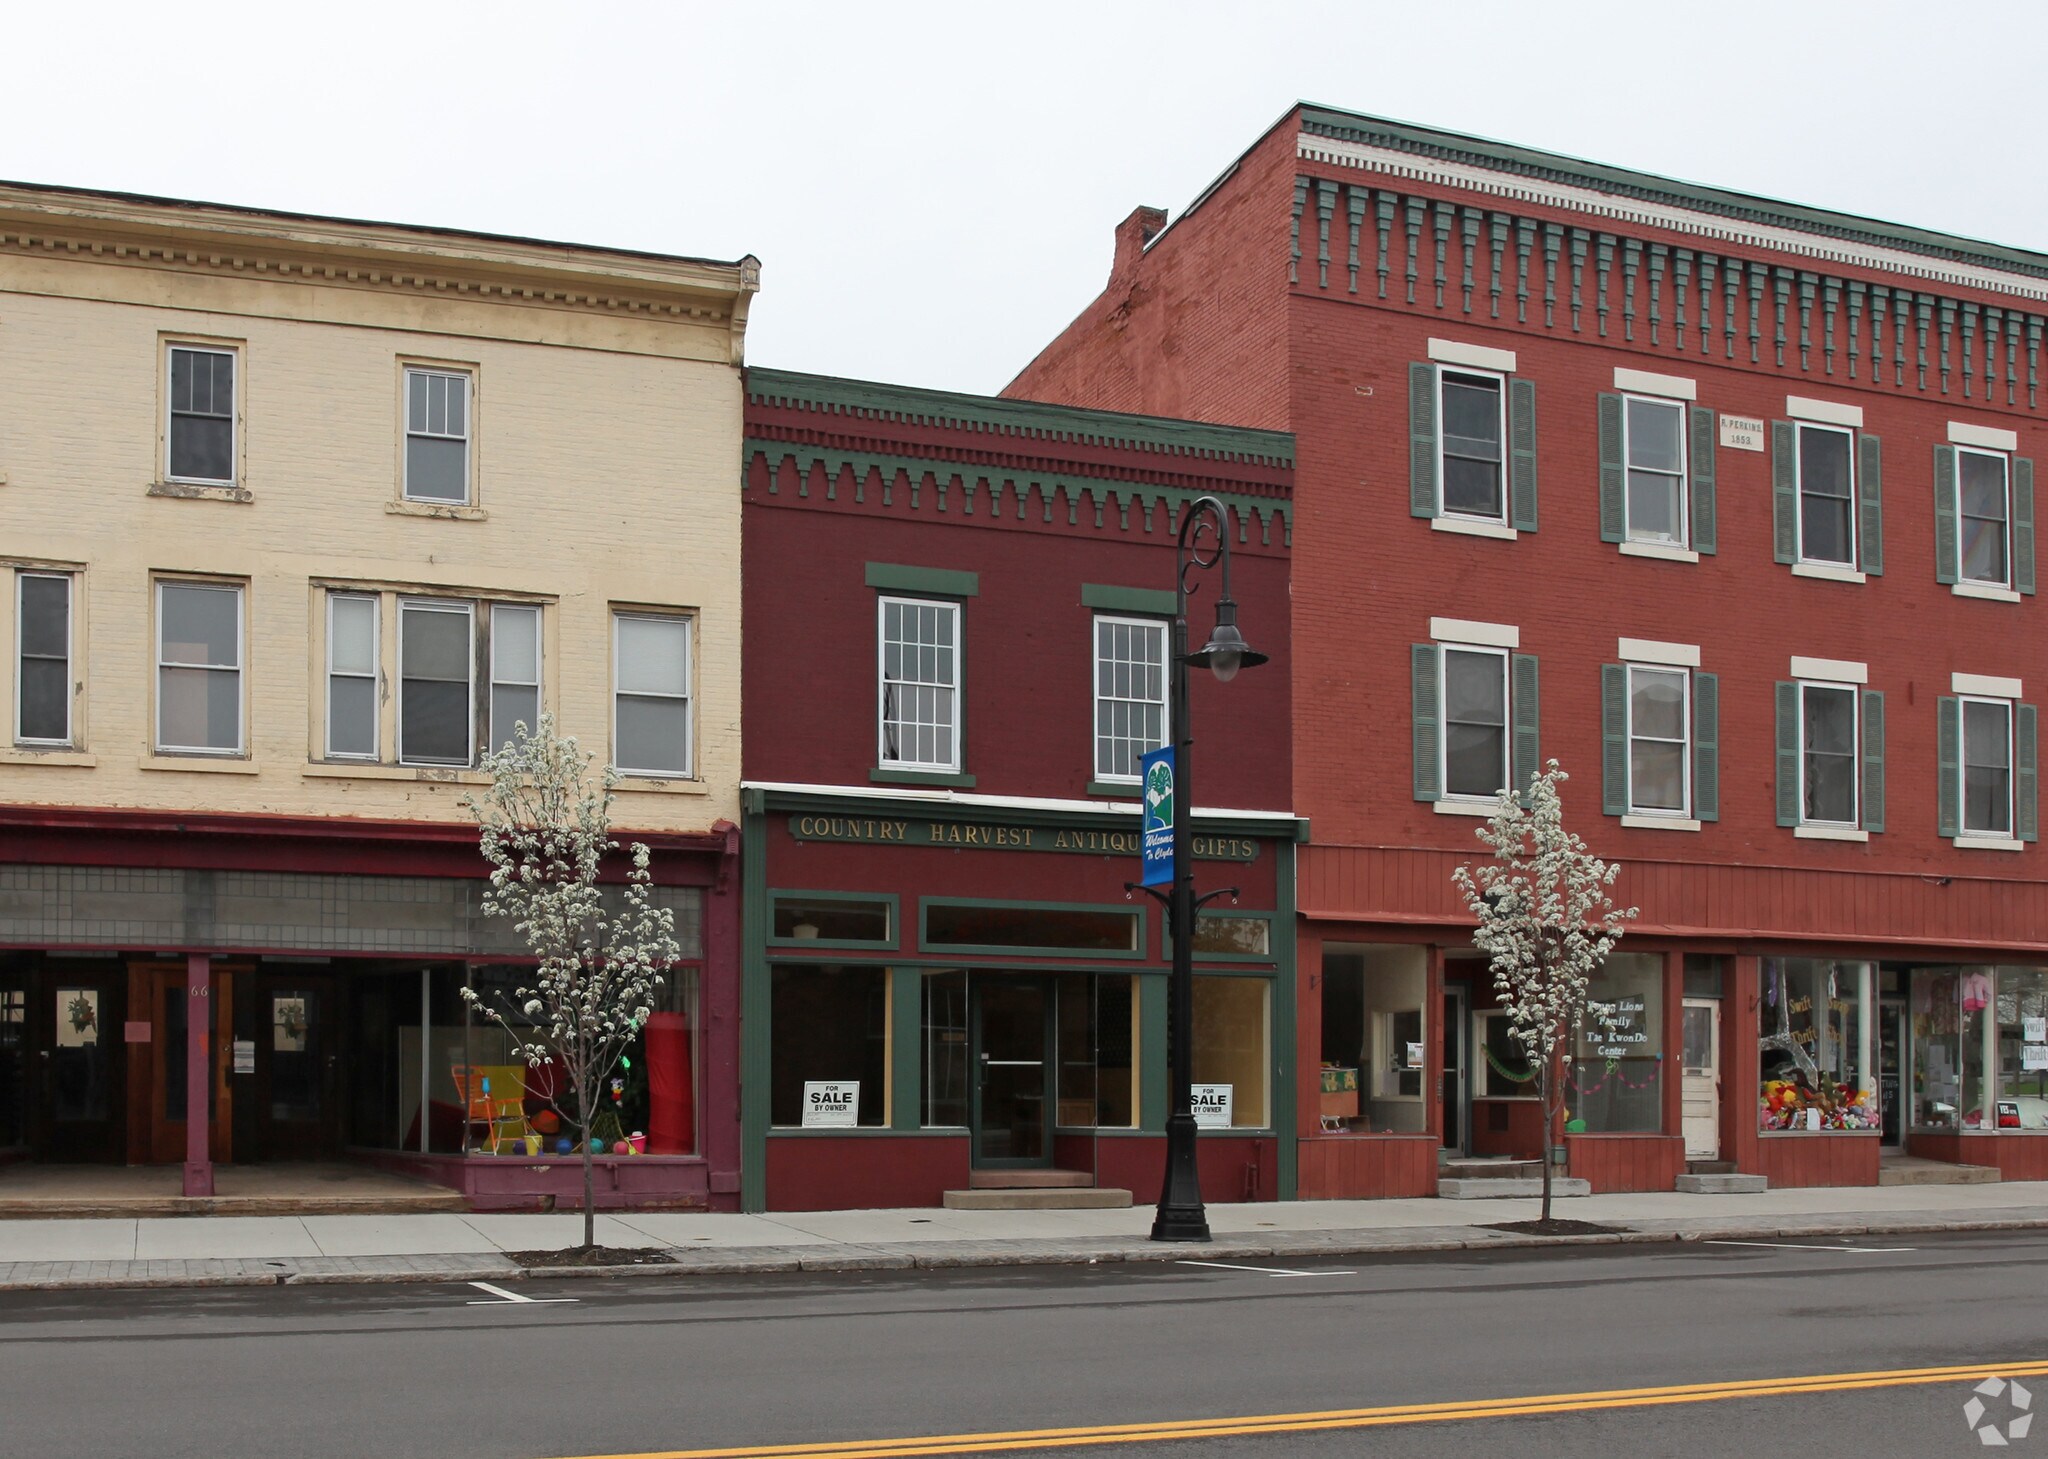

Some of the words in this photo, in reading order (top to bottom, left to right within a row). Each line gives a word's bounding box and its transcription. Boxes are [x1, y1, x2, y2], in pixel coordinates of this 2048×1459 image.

[800, 817, 908, 840] COUNTRY
[930, 823, 1034, 846] HARVEST
[1055, 830, 1139, 852] ANTIQU
[1192, 838, 1253, 857] GIFTS
[1145, 833, 1175, 848] Welcome
[1146, 850, 1155, 861] To
[1155, 847, 1175, 861] Clyde
[191, 985, 208, 997] 66
[1619, 1001, 1644, 1011] Lions
[1598, 1016, 1630, 1028] Family
[1586, 1032, 1603, 1042] Tae
[1598, 1045, 1627, 1055] Center
[810, 1092, 853, 1104] SALE
[1191, 1094, 1227, 1106] SALE
[814, 1104, 824, 1112] BY
[825, 1104, 848, 1112] OWNER
